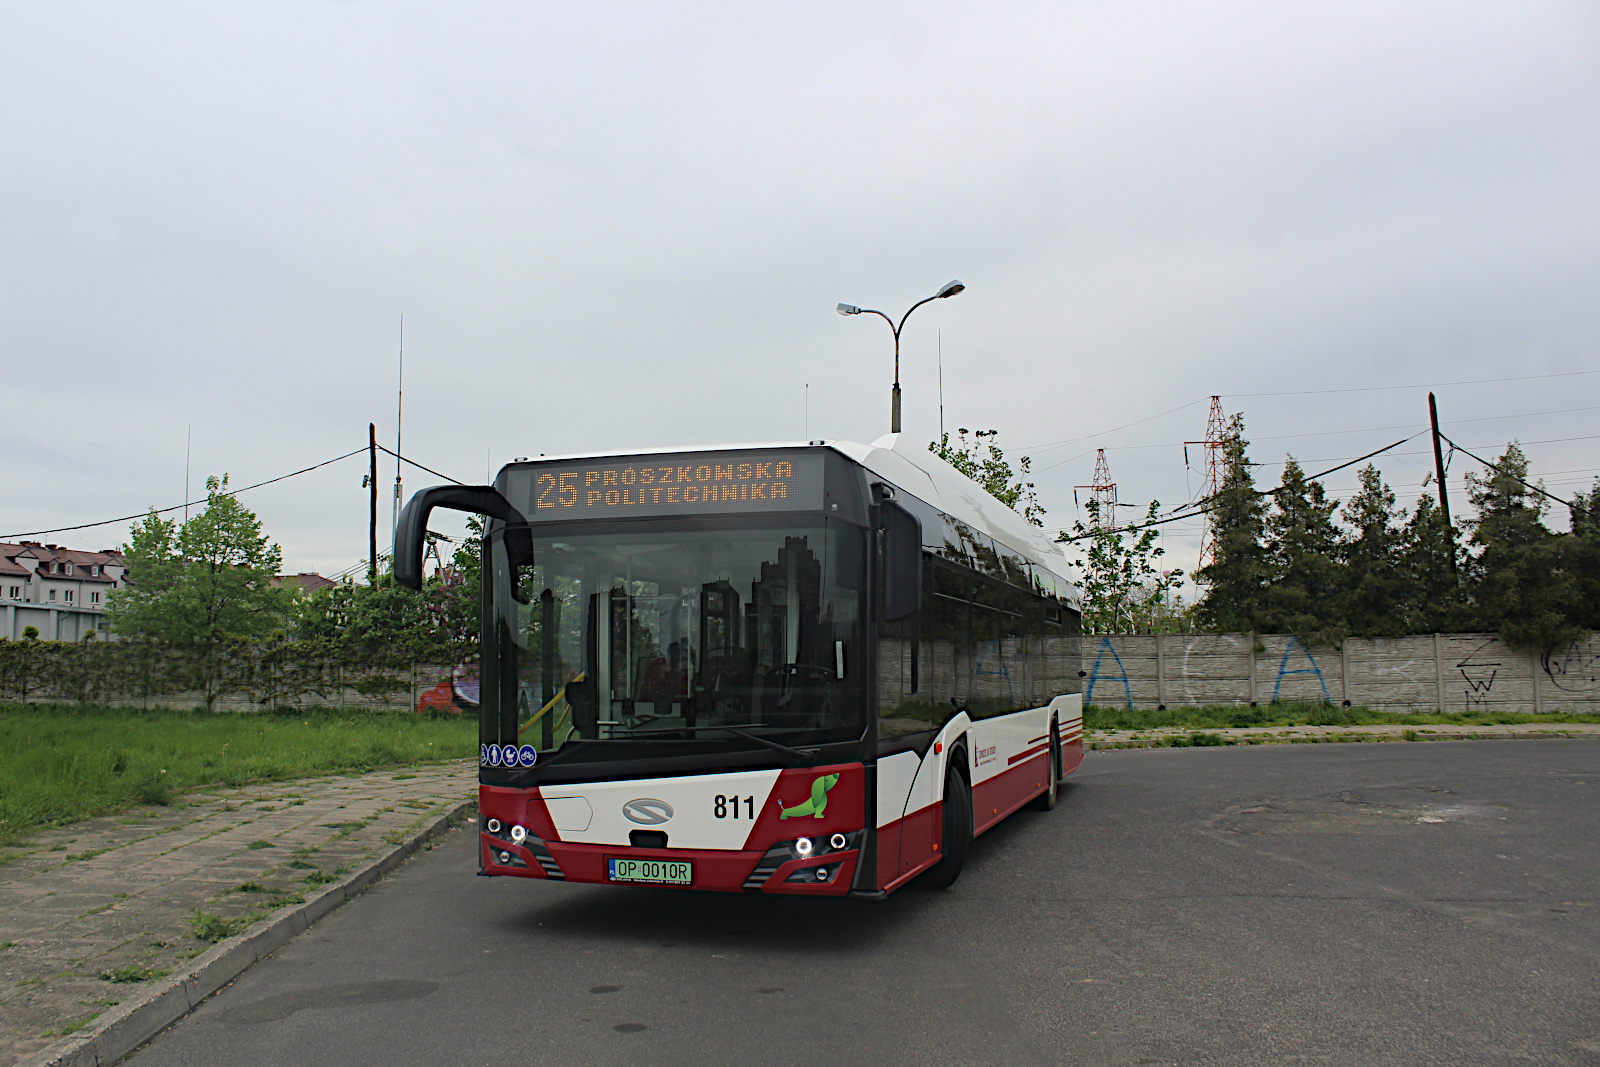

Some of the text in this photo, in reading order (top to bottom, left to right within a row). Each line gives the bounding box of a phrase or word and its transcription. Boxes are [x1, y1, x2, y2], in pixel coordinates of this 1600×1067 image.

[537, 472, 578, 508] 25
[586, 482, 787, 506] POLITECHNIKA
[714, 794, 754, 820] 811
